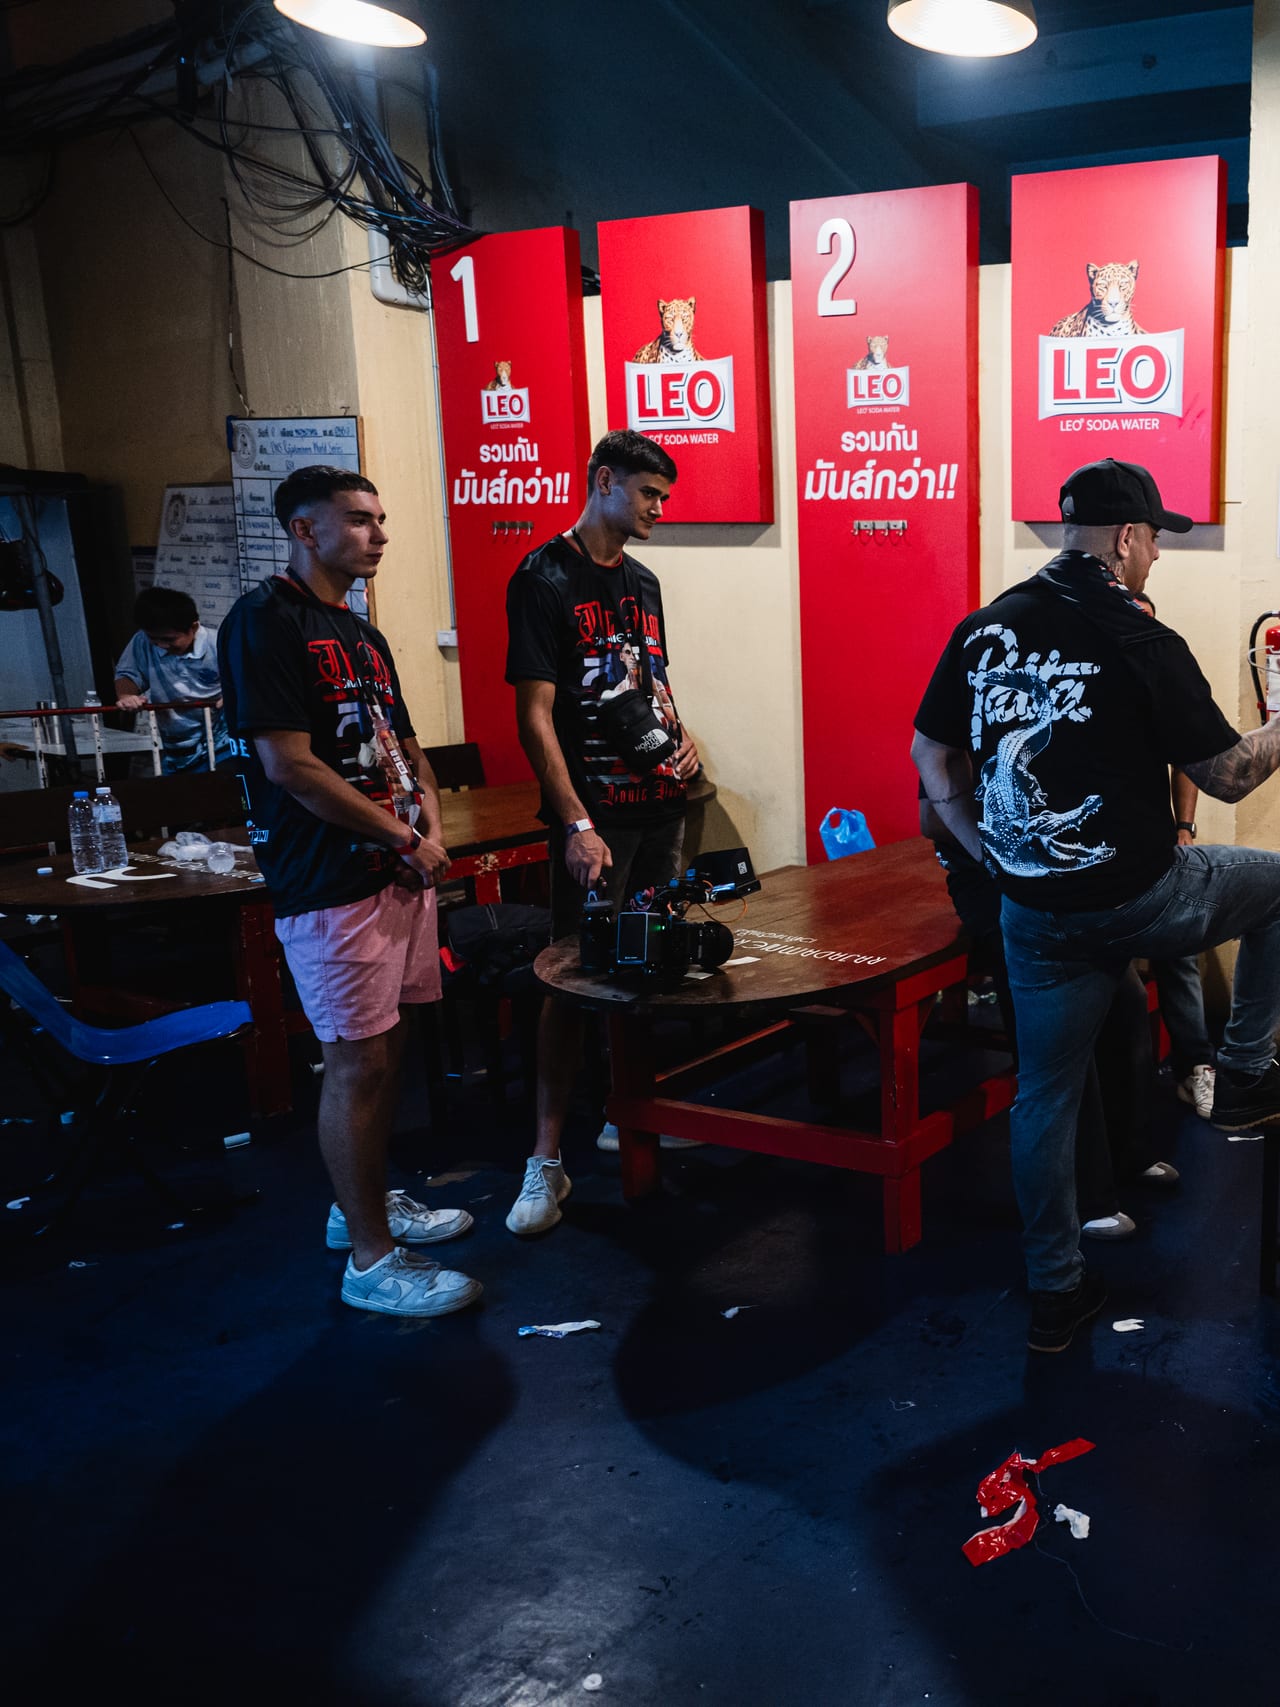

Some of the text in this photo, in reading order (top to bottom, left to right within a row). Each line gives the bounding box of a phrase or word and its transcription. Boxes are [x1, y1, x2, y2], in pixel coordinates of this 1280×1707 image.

[817, 218, 856, 316] 2
[450, 255, 479, 343] 1
[1053, 344, 1167, 400] LEO
[636, 370, 722, 418] LEO
[853, 373, 900, 400] LEO
[486, 394, 525, 417] LEO
[841, 424, 918, 452] รวมกัน
[1086, 419, 1120, 431] SODA
[1121, 418, 1160, 430] WATER
[479, 437, 538, 463] รวมกัน
[664, 434, 689, 445] SODA
[689, 433, 719, 444] WATER
[453, 468, 570, 505] มันส์กว่า!!
[804, 458, 958, 500] มันส์กว่า!!
[239, 542, 245, 552] 2
[241, 563, 246, 573] 3
